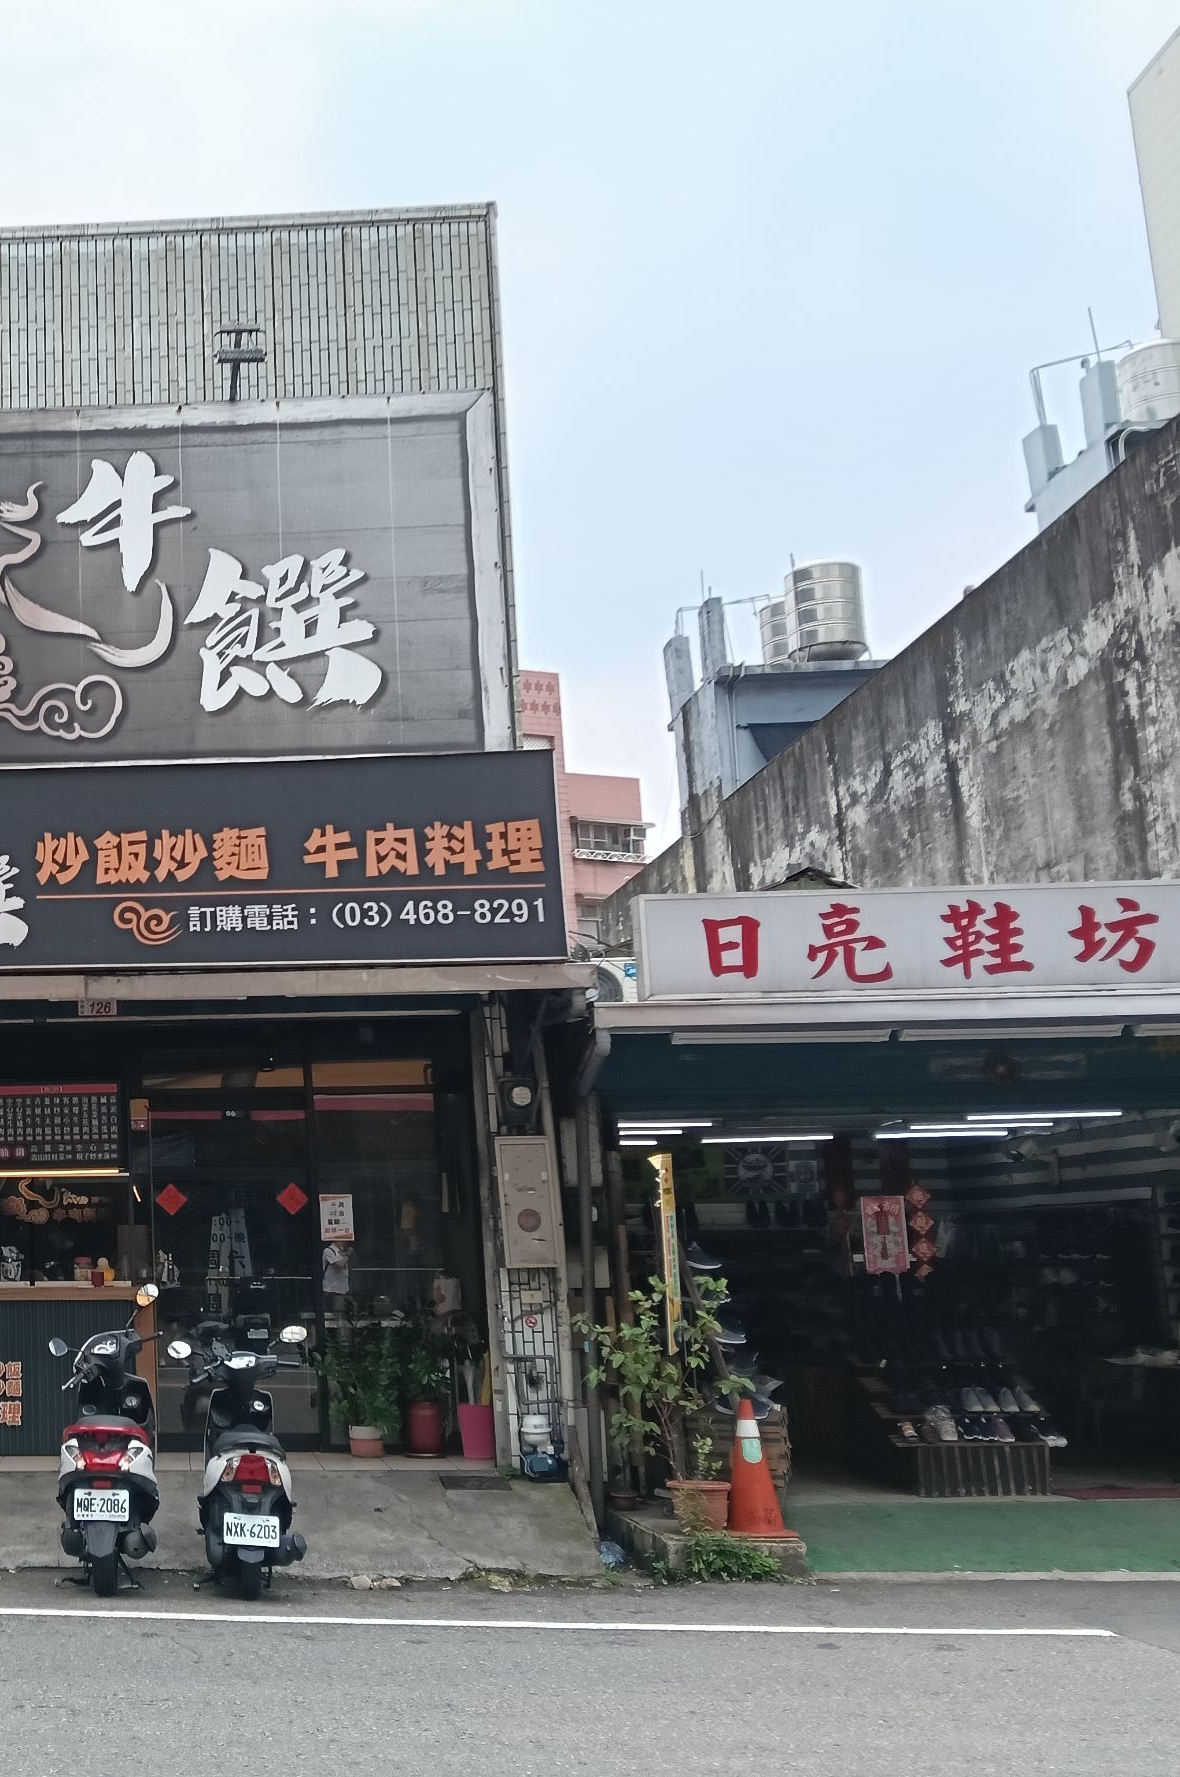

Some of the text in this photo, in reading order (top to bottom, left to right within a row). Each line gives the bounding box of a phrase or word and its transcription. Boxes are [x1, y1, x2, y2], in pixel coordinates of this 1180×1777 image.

[35, 819, 545, 885] 炒飯炒麵 牛肉料理
[701, 898, 1159, 983] 日亮鞋坊
[90, 1001, 111, 1014] 126
